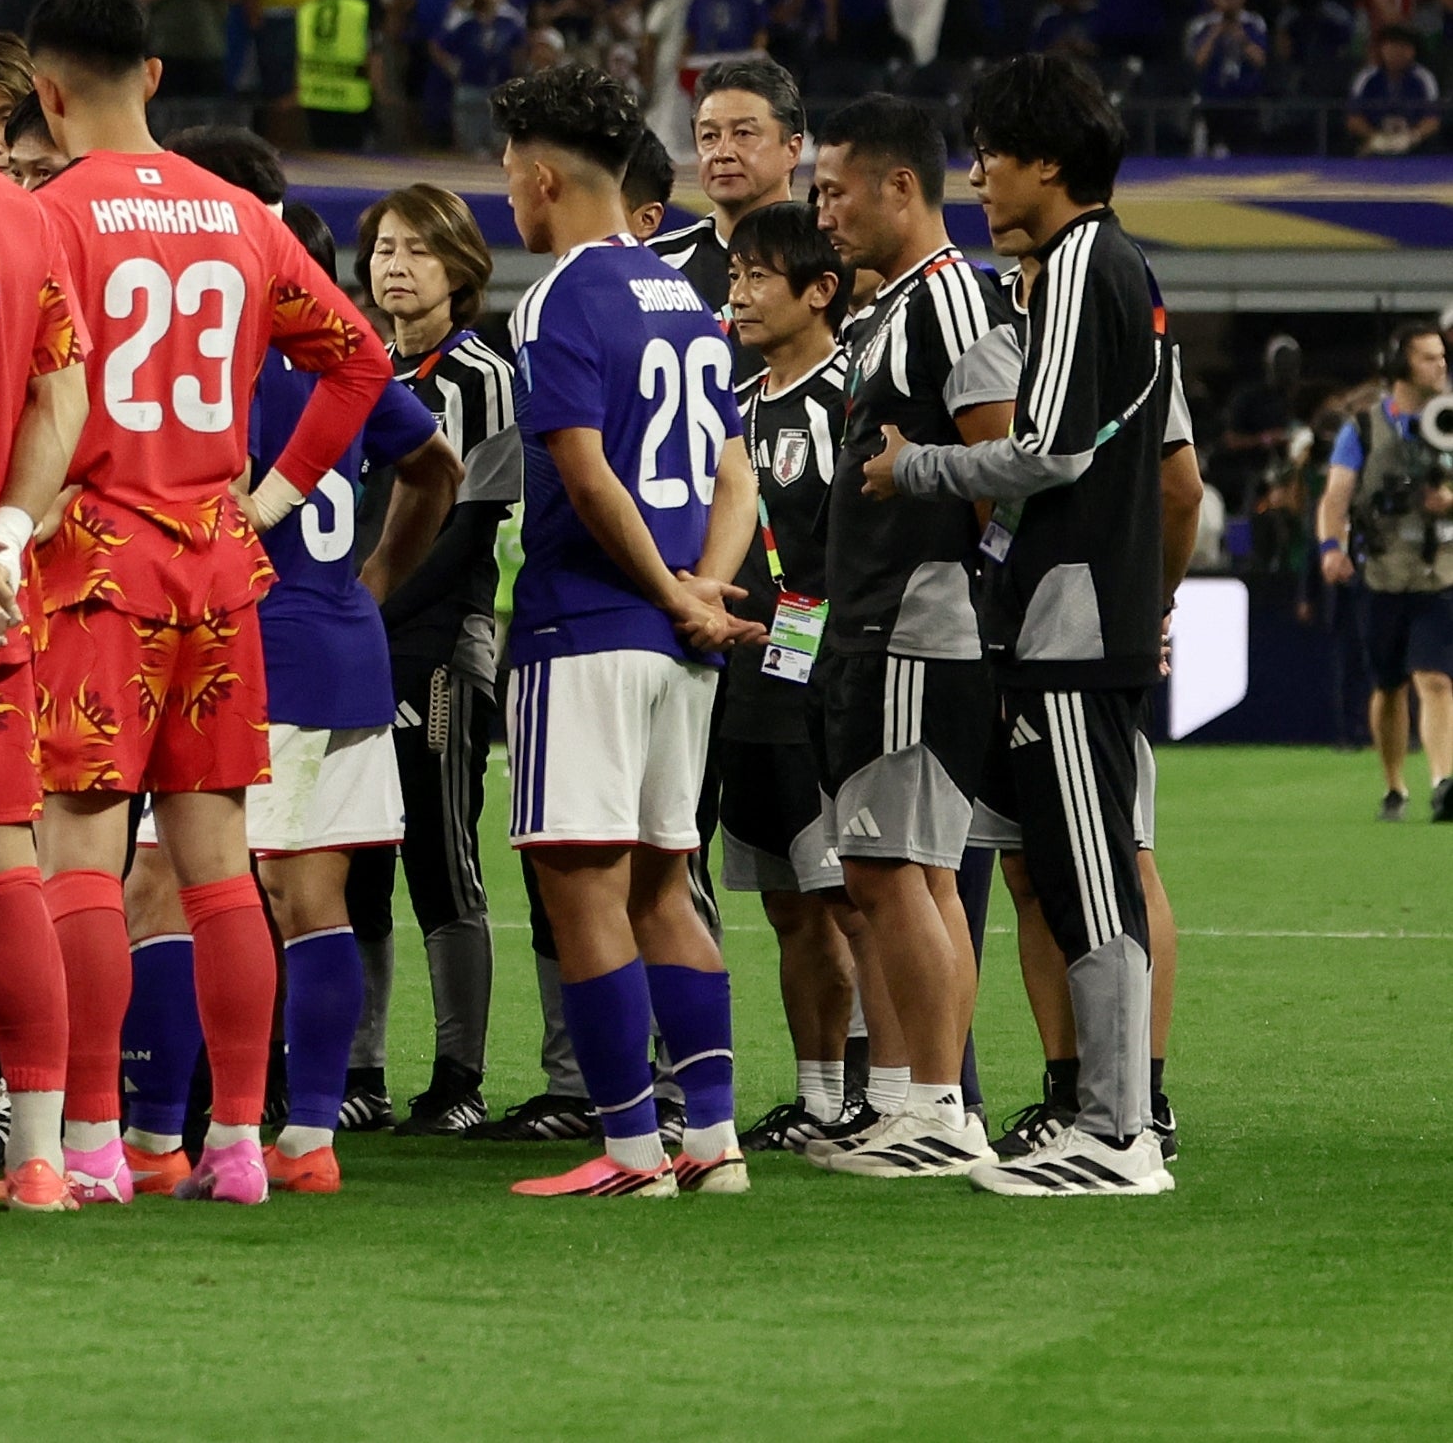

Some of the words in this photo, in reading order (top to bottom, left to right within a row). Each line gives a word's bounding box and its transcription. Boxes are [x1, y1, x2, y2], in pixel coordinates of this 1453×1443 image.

[90, 198, 239, 235] HAYAKAWA
[104, 258, 246, 433] 23
[629, 279, 703, 312] SHIOGAI
[638, 336, 732, 509] 26
